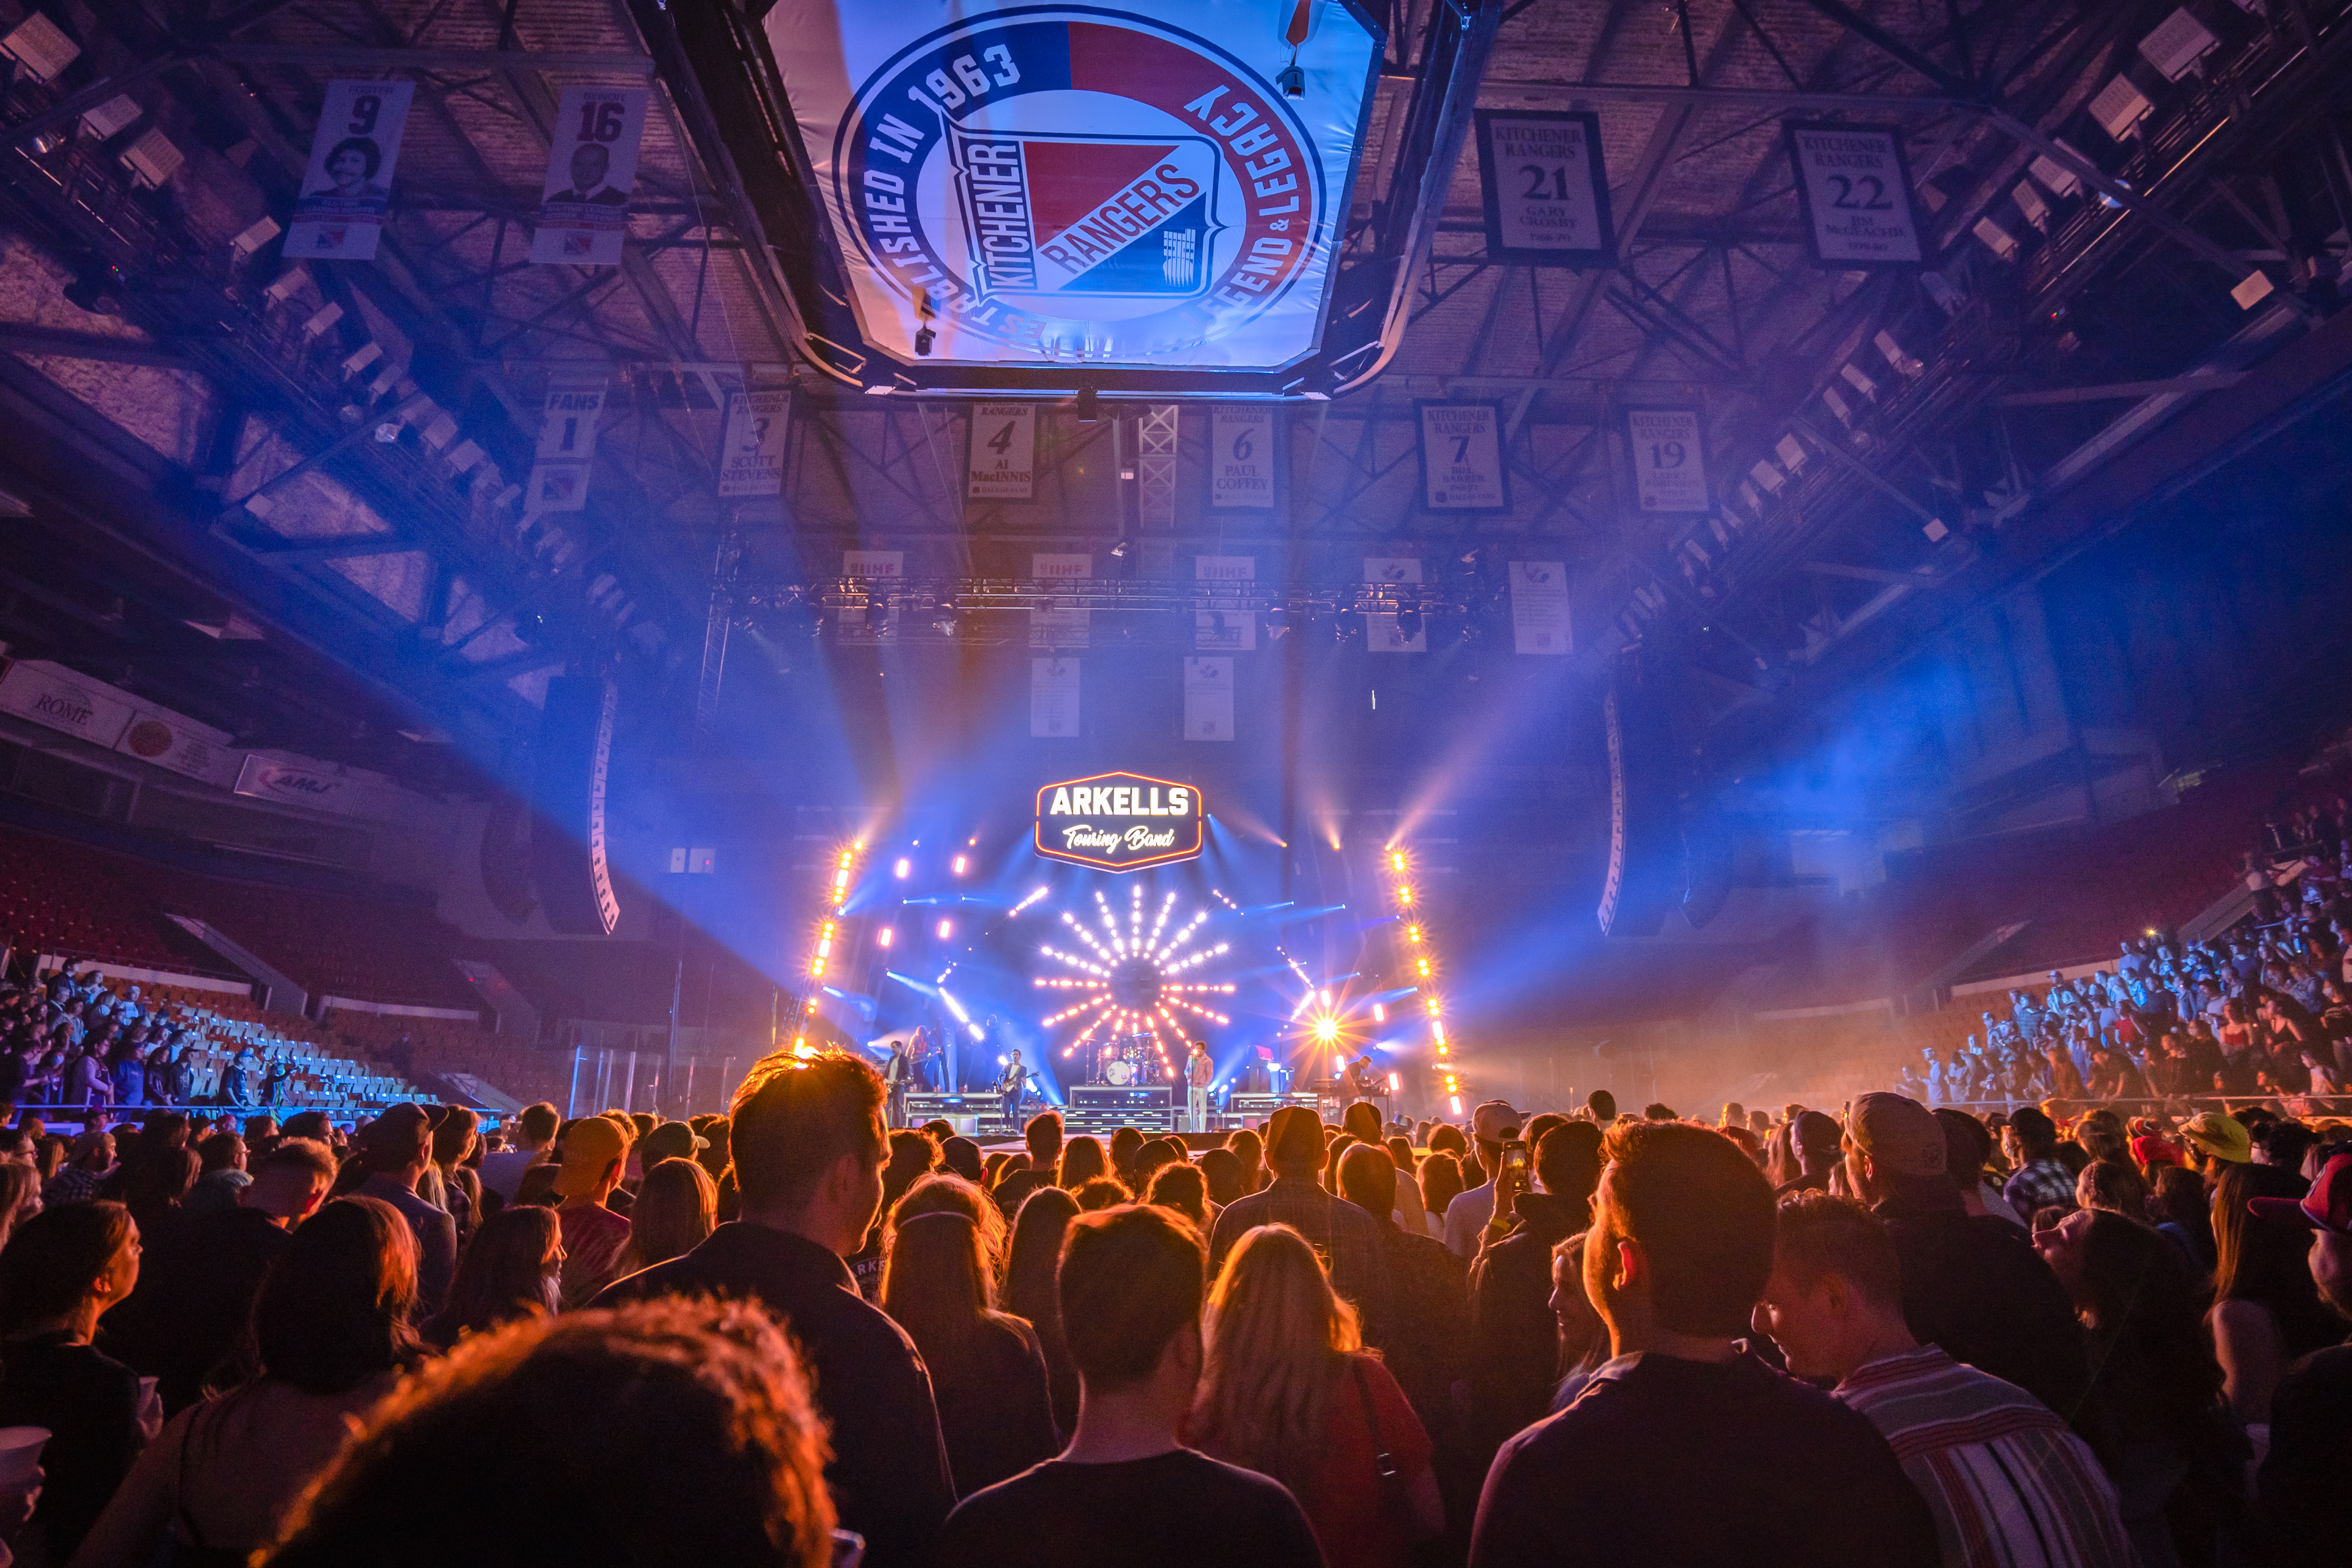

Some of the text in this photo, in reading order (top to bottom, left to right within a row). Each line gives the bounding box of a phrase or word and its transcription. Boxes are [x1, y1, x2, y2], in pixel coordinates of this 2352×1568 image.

[908, 44, 1021, 111] 1963
[348, 95, 381, 135] 9
[576, 102, 625, 142] 16
[869, 113, 925, 164] IN
[1495, 126, 1581, 143] KITCHENER
[1505, 143, 1575, 159] RANGERS
[1803, 137, 1887, 153] KITCHENER
[1814, 153, 1884, 169] RANGERS
[1519, 164, 1572, 201] 21
[1826, 174, 1893, 210] 22
[1180, 84, 1299, 329] LEGEND & LEGACY
[1527, 207, 1567, 217] GARY
[967, 144, 1035, 287] KITCHENER
[1040, 164, 1199, 275] RANGERS
[1519, 216, 1578, 229] CROSBY
[863, 169, 1047, 340] ESTABLISHED
[549, 394, 600, 410] FANS
[1213, 406, 1272, 414] KITCHENER
[980, 407, 1028, 416] RANGERS
[1221, 415, 1265, 423] RANGERS
[1428, 410, 1489, 421] KITCHENER
[1435, 423, 1486, 434] RANGERS
[1632, 416, 1694, 427] KITCHENER
[742, 417, 770, 452] 3
[987, 420, 1016, 454] 4
[1640, 427, 1691, 439] RANGERS
[1233, 428, 1254, 461] 6
[1449, 436, 1470, 463] 7
[731, 455, 776, 468] SCOTT
[1651, 441, 1686, 468] 19
[722, 468, 781, 481] STEVENS
[971, 471, 1031, 482] MacINNIS
[1225, 465, 1260, 477] PAUL
[1216, 478, 1268, 490] COFFEY
[859, 562, 894, 574] IIHF
[1049, 564, 1083, 575] IIHF
[1212, 566, 1247, 578] IIHF
[35, 693, 93, 725] ROME
[274, 775, 332, 793] AMJ
[1049, 787, 1189, 815] ARKELLS
[1062, 824, 1175, 854] Touring Band
[852, 1260, 886, 1278] RKE
